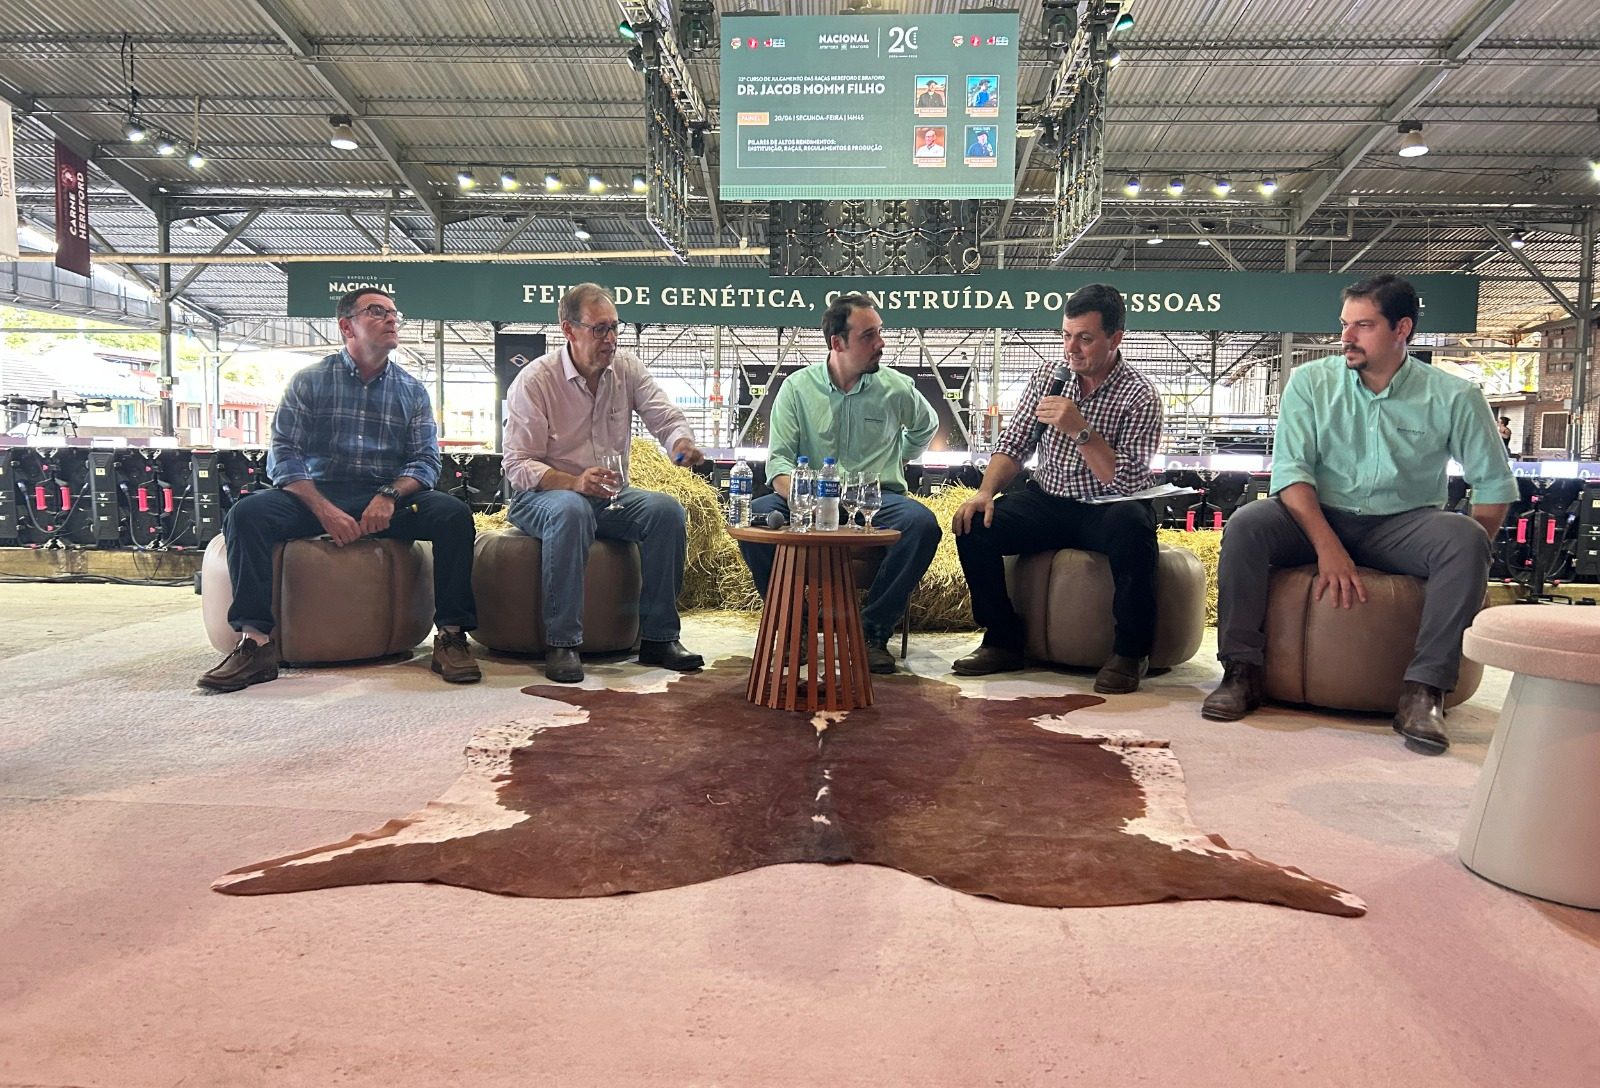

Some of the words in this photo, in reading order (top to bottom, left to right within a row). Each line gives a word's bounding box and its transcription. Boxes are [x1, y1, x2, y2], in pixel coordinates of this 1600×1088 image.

[819, 34, 869, 43] NACIONAL
[738, 83, 759, 96] DR.
[760, 83, 802, 95] JACOB
[803, 83, 845, 95] MOMM
[847, 82, 886, 94] FILHO
[748, 144, 784, 152] INSTITUIÇÃO,
[803, 144, 847, 152] REGULAMENTOS
[852, 143, 883, 152] PRODUÇÃO
[68, 191, 77, 236] CARNE
[77, 172, 87, 240] HEREFORD
[614, 286, 651, 305] DE
[660, 284, 816, 311] GENÉTICA,
[824, 285, 1015, 310] CNSTRUÍDA
[1024, 290, 1076, 311] PO
